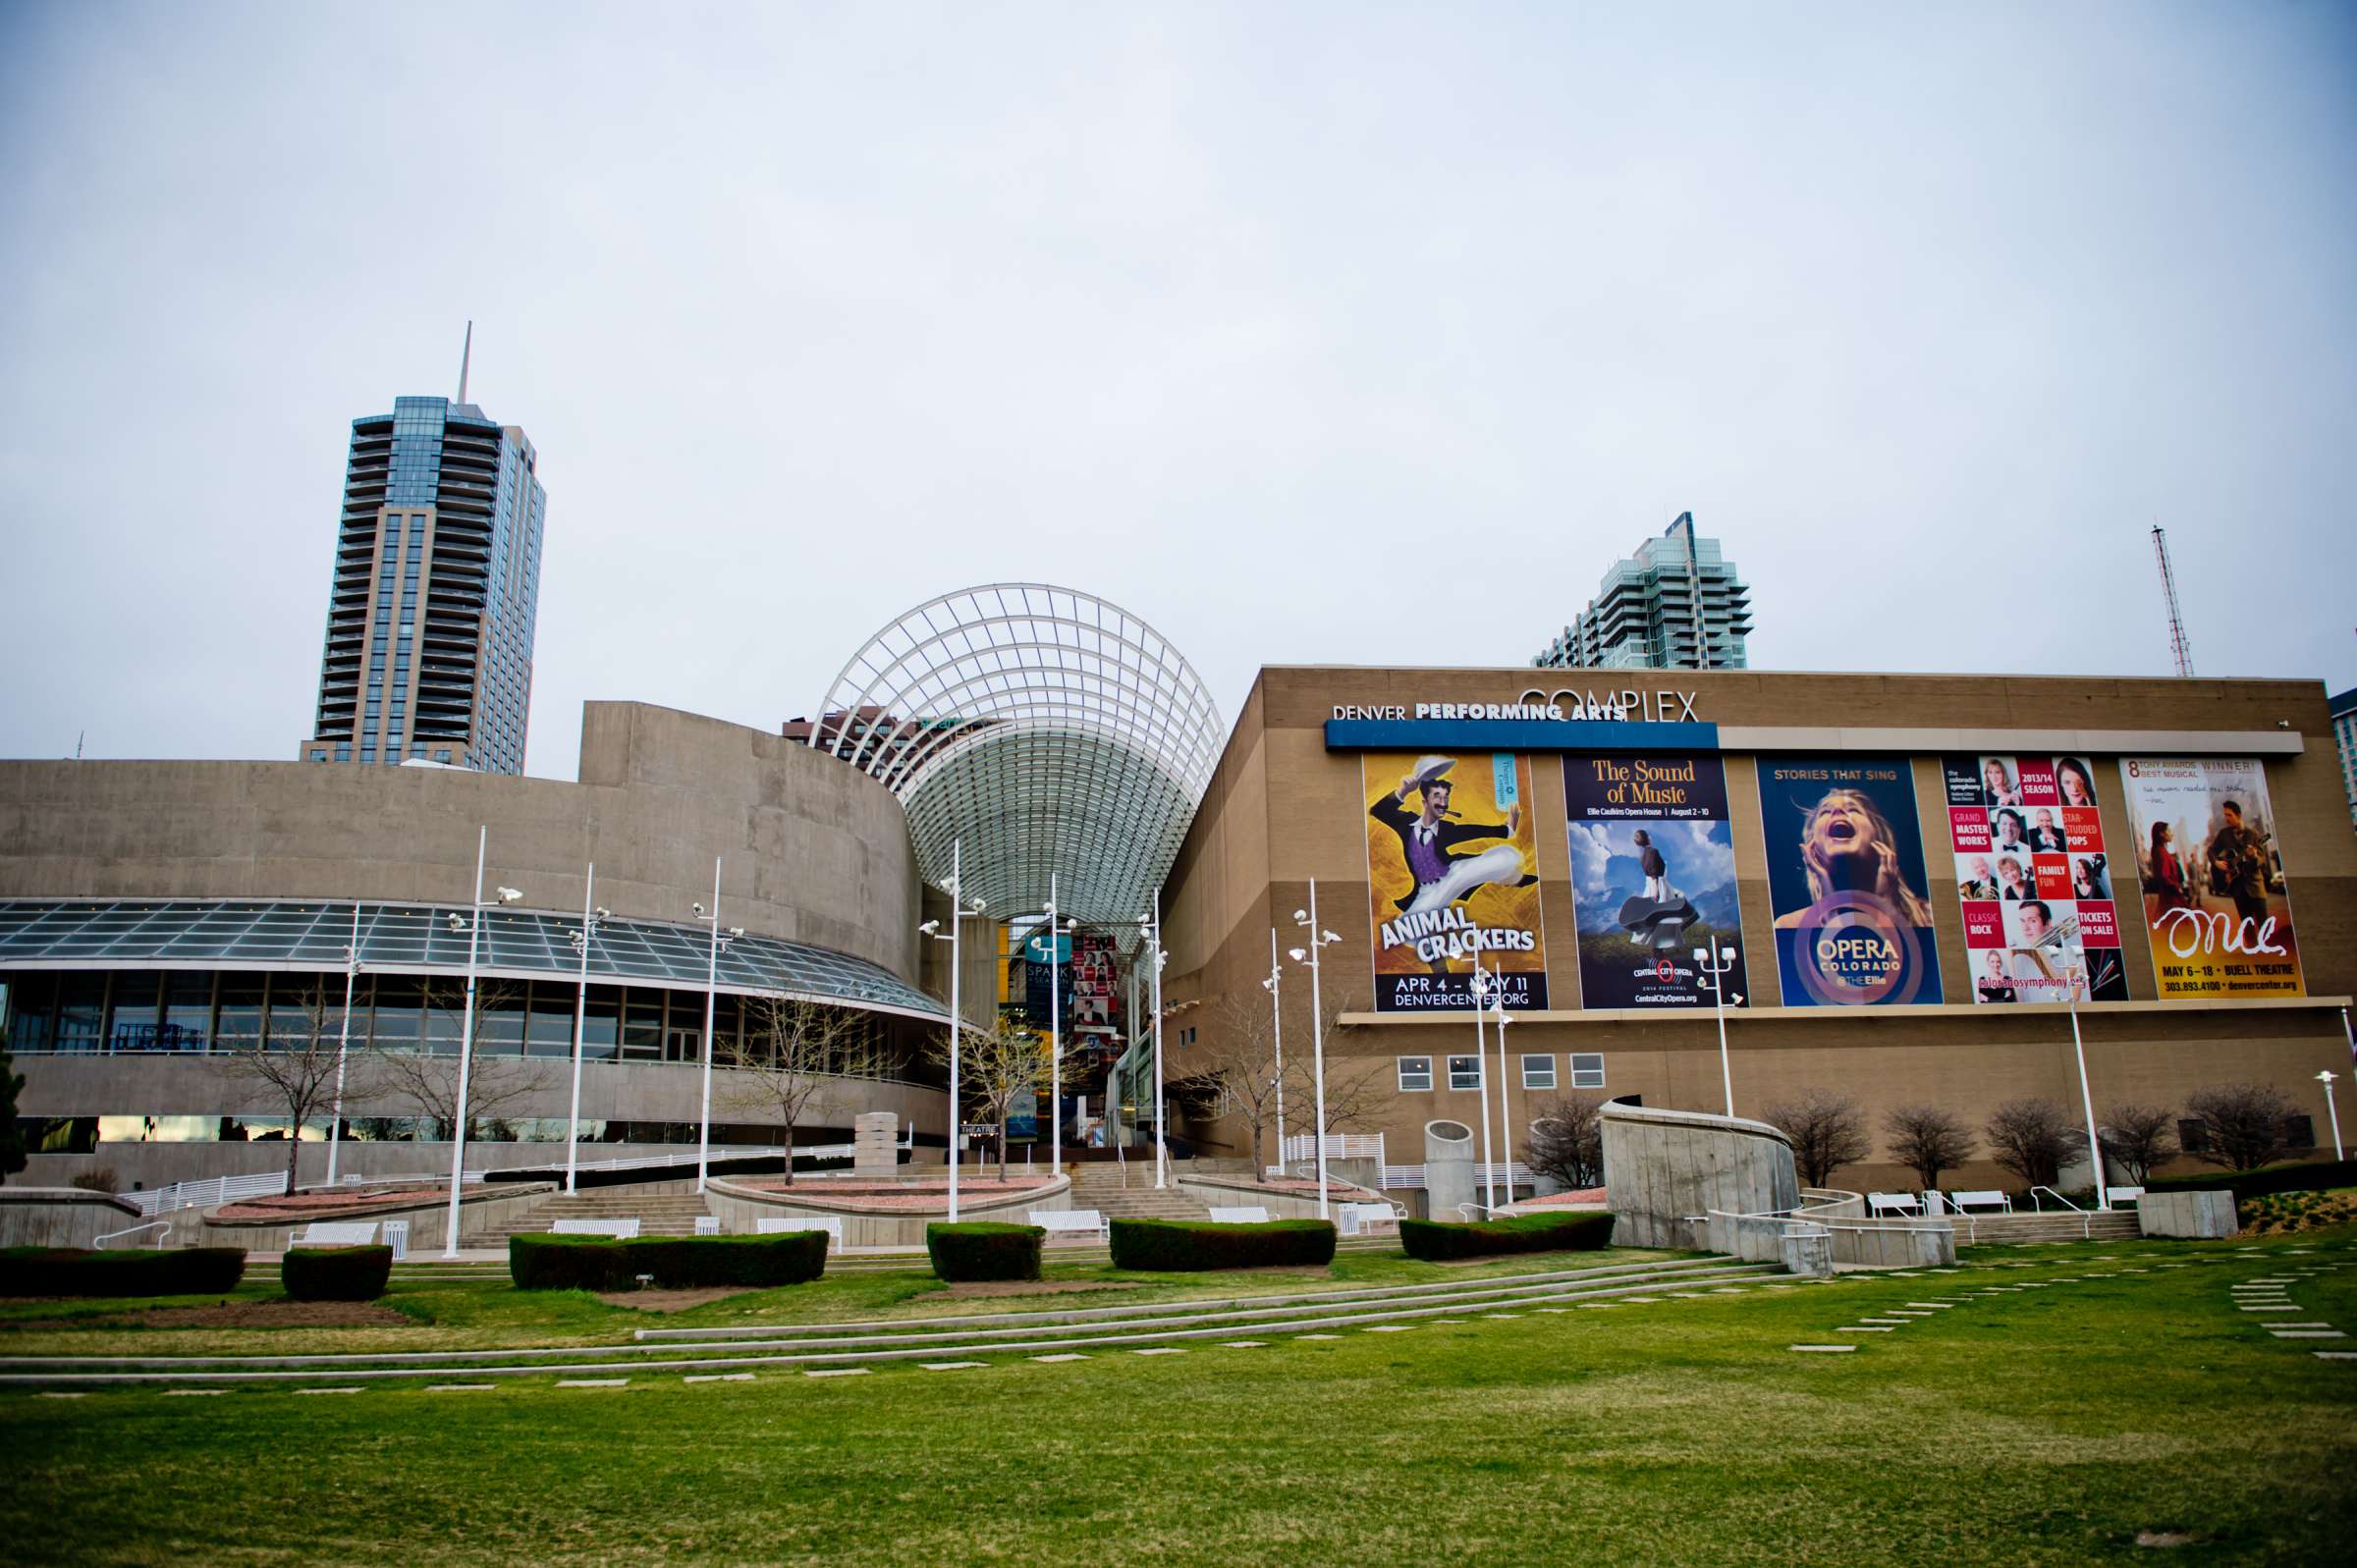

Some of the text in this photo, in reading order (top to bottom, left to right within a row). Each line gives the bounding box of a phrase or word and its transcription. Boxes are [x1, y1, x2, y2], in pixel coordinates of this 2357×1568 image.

[1333, 688, 1700, 724] DENVER PERFORMING ARTS COMPLEX
[1592, 759, 1696, 783] The Sound
[2201, 761, 2256, 771] WINNER!
[1774, 769, 1897, 781] STORIES THAT SING
[2022, 773, 2053, 783] 2013/14
[2140, 770, 2162, 779] BEST
[2163, 770, 2199, 779] MUSICAL
[1607, 782, 1687, 804] of Music
[2024, 784, 2055, 794] SEASON
[1625, 807, 1643, 817] Opera
[1643, 807, 1662, 816] House
[1671, 807, 1693, 817] August
[1954, 813, 1980, 823] GRAND
[2063, 813, 2084, 823] STAR-
[1955, 824, 1989, 834] MASTER
[2065, 824, 2098, 835] STUDDED
[1956, 836, 1989, 845] WORKS
[2067, 836, 2089, 845] POPS
[2037, 865, 2066, 876] FAMILY
[2039, 877, 2056, 888] FUN
[1968, 912, 1999, 924] CLASSIC
[2078, 911, 2112, 923] TICKETS
[1380, 906, 1474, 951] ANIMAL
[1970, 925, 1993, 935] ROCK
[2080, 925, 2113, 936] ON SALE!
[1416, 928, 1536, 963] CRACKERS
[1816, 939, 1899, 959] OPERA
[1027, 965, 1069, 978] SPAK
[1820, 961, 1901, 972] COLORADO
[2163, 964, 2183, 977] MAY
[2224, 964, 2253, 976] BUELL
[2256, 963, 2295, 975] THEATRE
[1633, 968, 1659, 978] CENTRAL
[1673, 968, 1694, 977] OPERA
[1396, 977, 1430, 992] APR
[1437, 978, 1448, 991] 4
[1516, 977, 1527, 991] 11
[1978, 974, 2086, 990] coloradosymphonyorg
[2165, 981, 2298, 993] 303.893.4100 denvercenter.org
[1396, 993, 1529, 1005] DENVERCENTERORG
[1634, 994, 1698, 1003] CentralCityOpera.org
[961, 1125, 997, 1134] THEATRE
